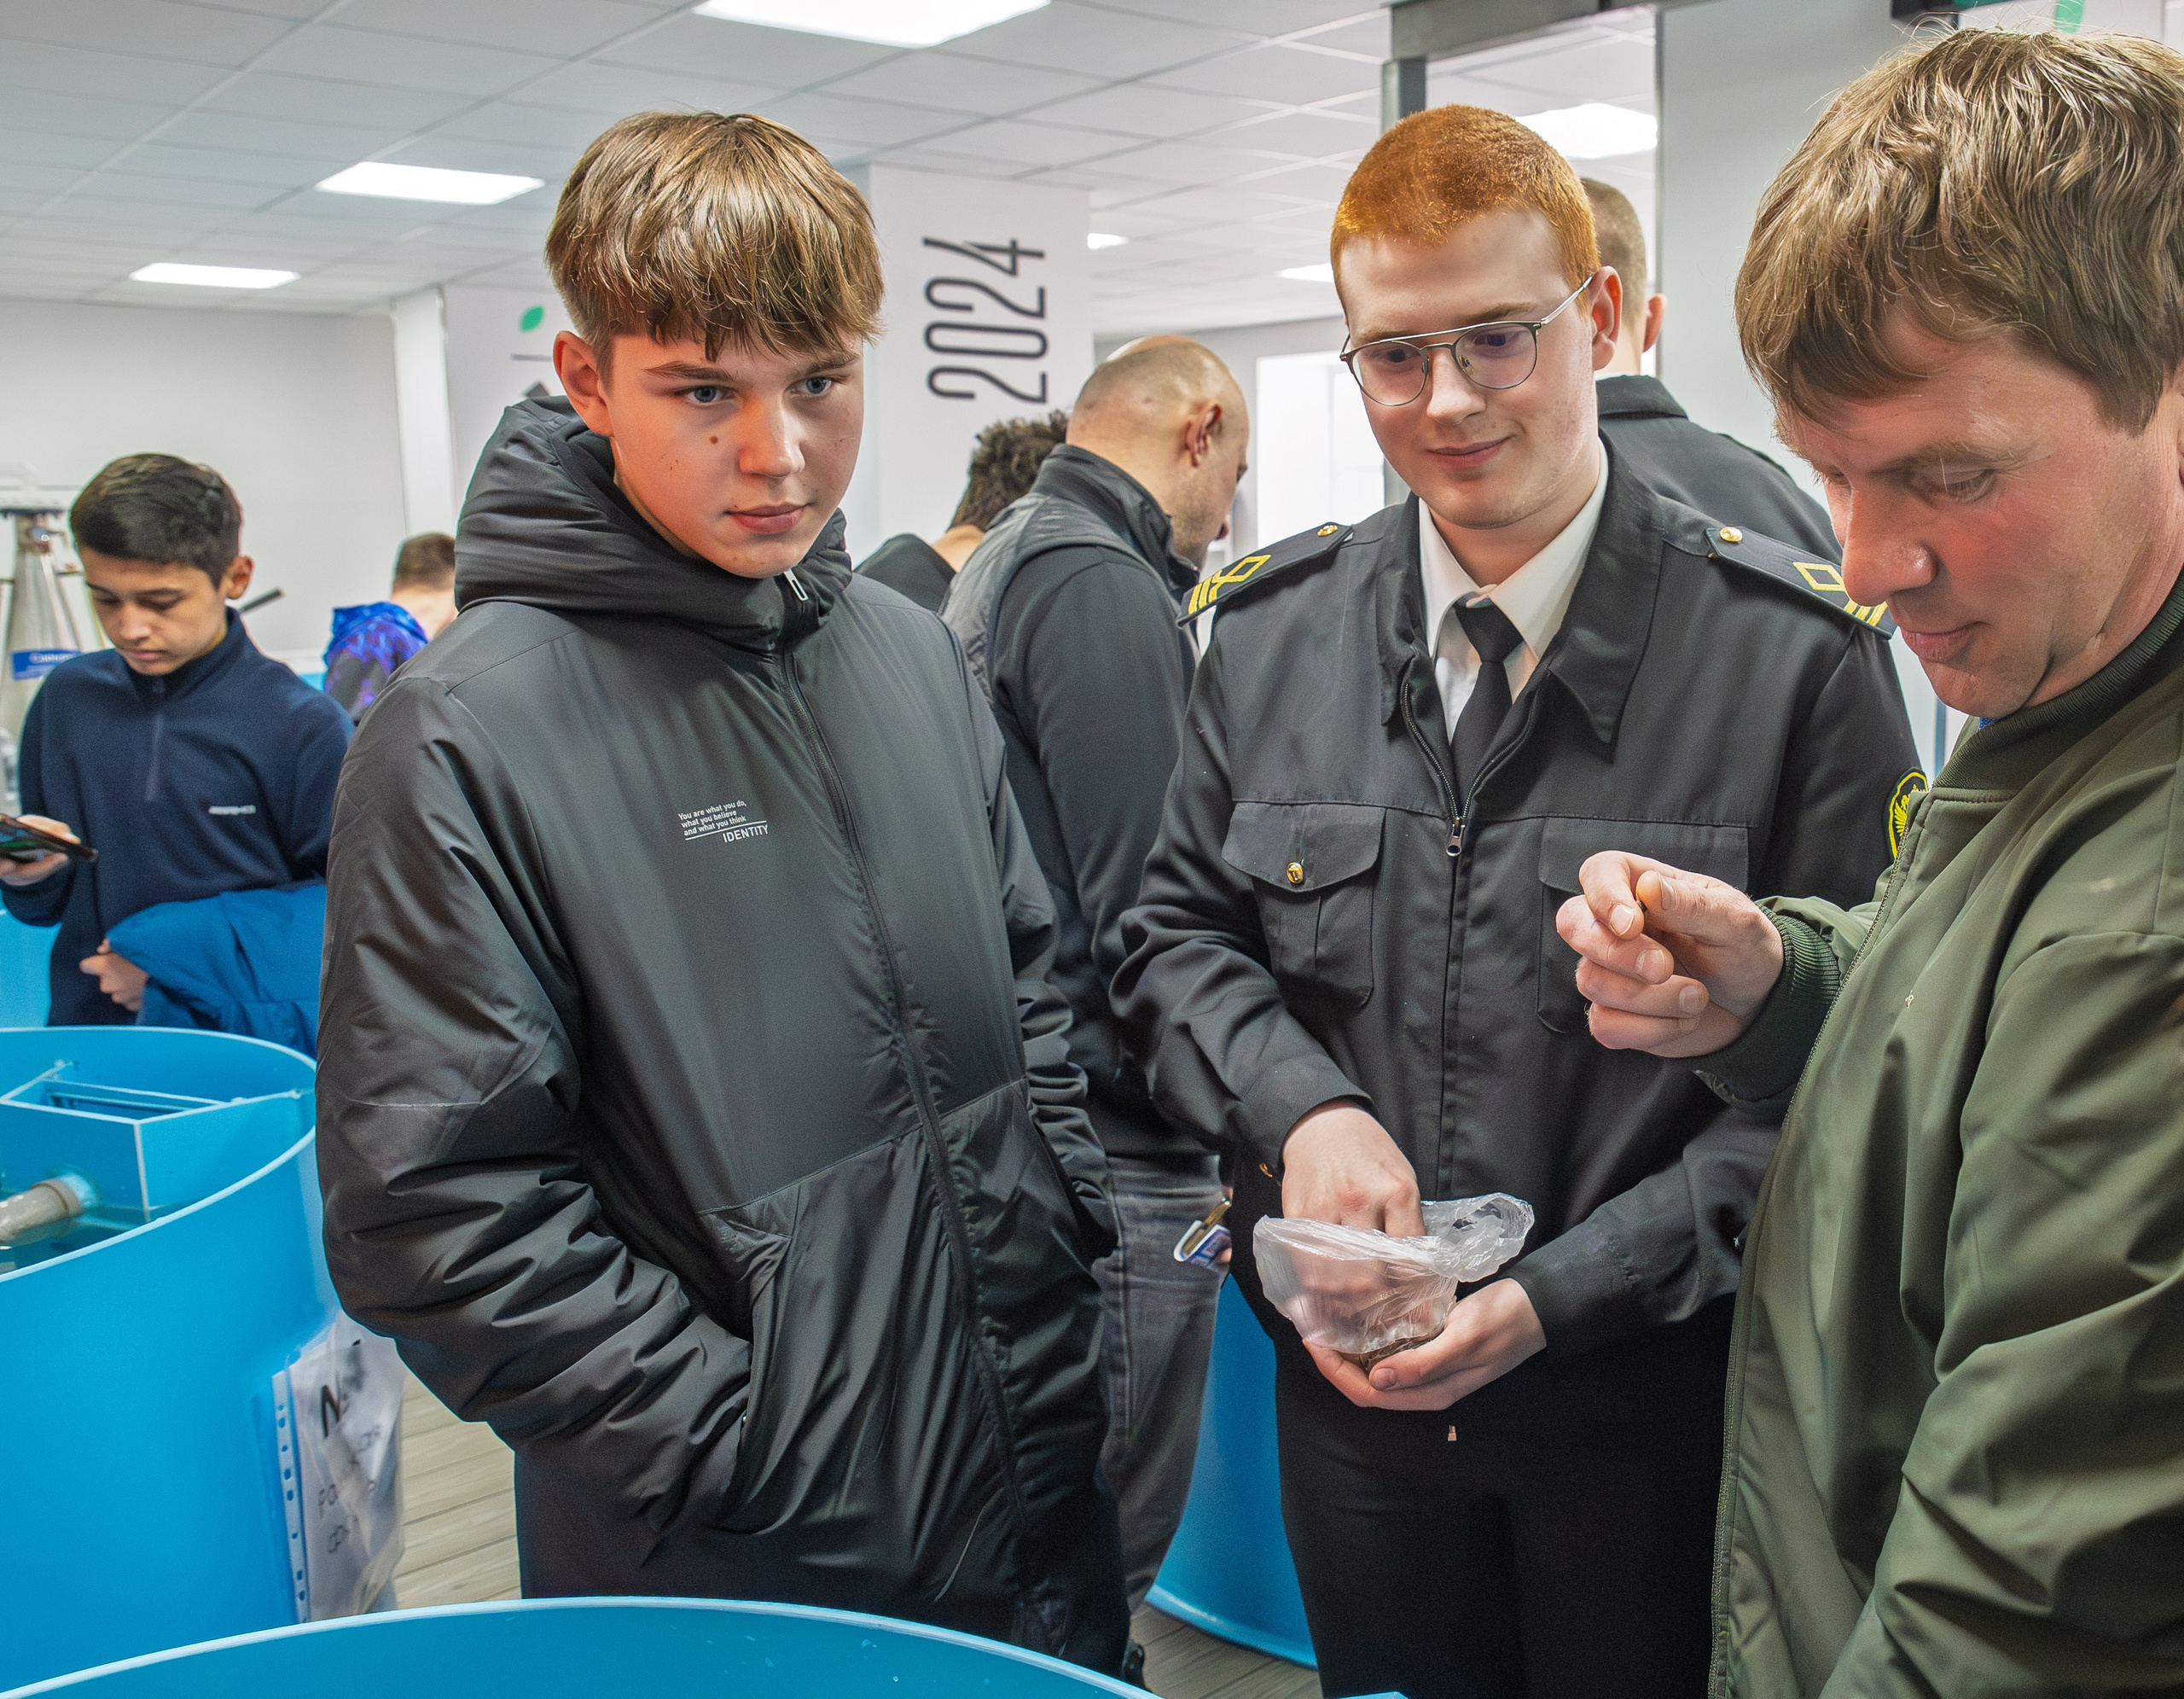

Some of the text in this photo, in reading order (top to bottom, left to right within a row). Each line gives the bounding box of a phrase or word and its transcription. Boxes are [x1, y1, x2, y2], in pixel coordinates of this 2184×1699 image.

[923, 236, 1048, 404] 2024
[706, 805, 723, 814] what
[723, 802, 735, 811] you
[681, 810, 736, 828] what you believe
[683, 816, 746, 836] and what you think
[723, 824, 769, 842] IDENTITY
